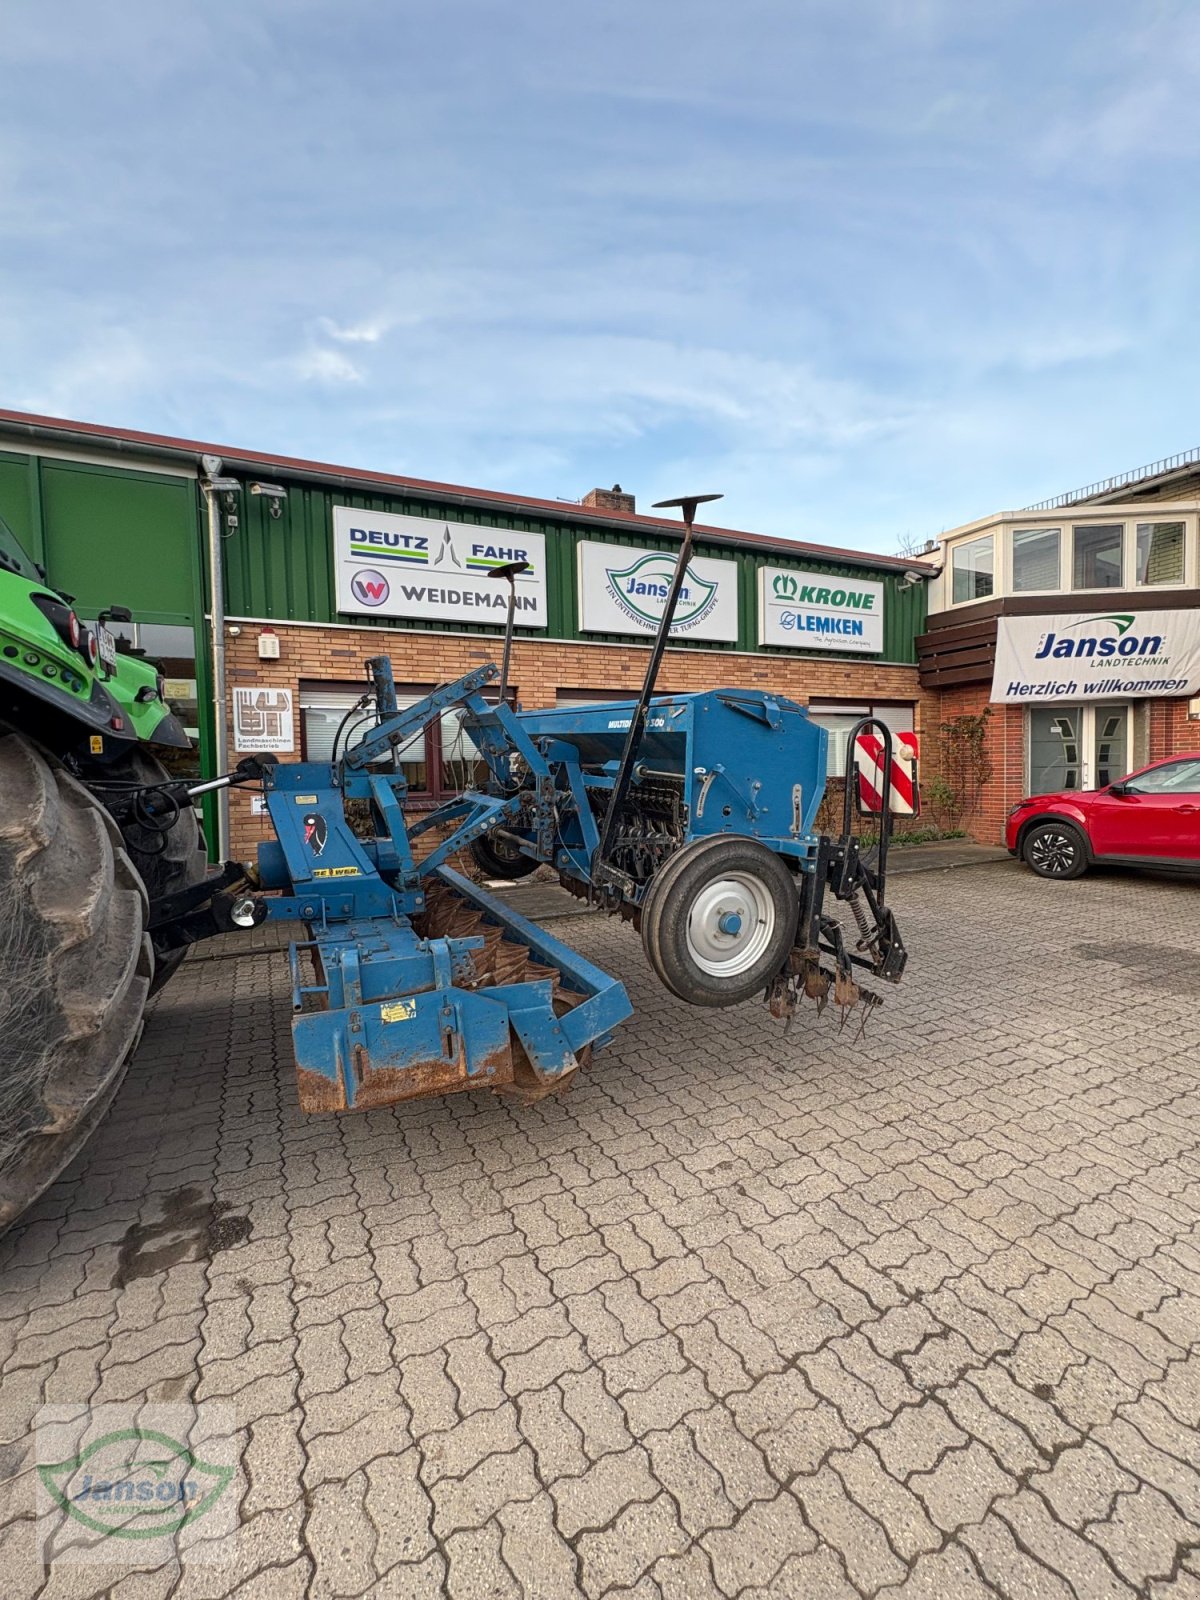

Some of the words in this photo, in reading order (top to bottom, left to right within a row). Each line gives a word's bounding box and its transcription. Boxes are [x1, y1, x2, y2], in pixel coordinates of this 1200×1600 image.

[350, 528, 429, 550] DEUTZ
[472, 544, 528, 562] FAHR
[400, 585, 537, 611] WEIDEMANN
[626, 578, 689, 600] Jansn
[798, 586, 876, 610] KRONE
[605, 584, 617, 600] EIN
[614, 598, 659, 632] UNTERNEHME
[796, 614, 863, 637] LEMKEN
[1035, 633, 1162, 659] Janson
[1090, 656, 1170, 668] LANDTECHNIK
[1006, 680, 1078, 696] Herzlich
[1083, 678, 1189, 695] willkommen
